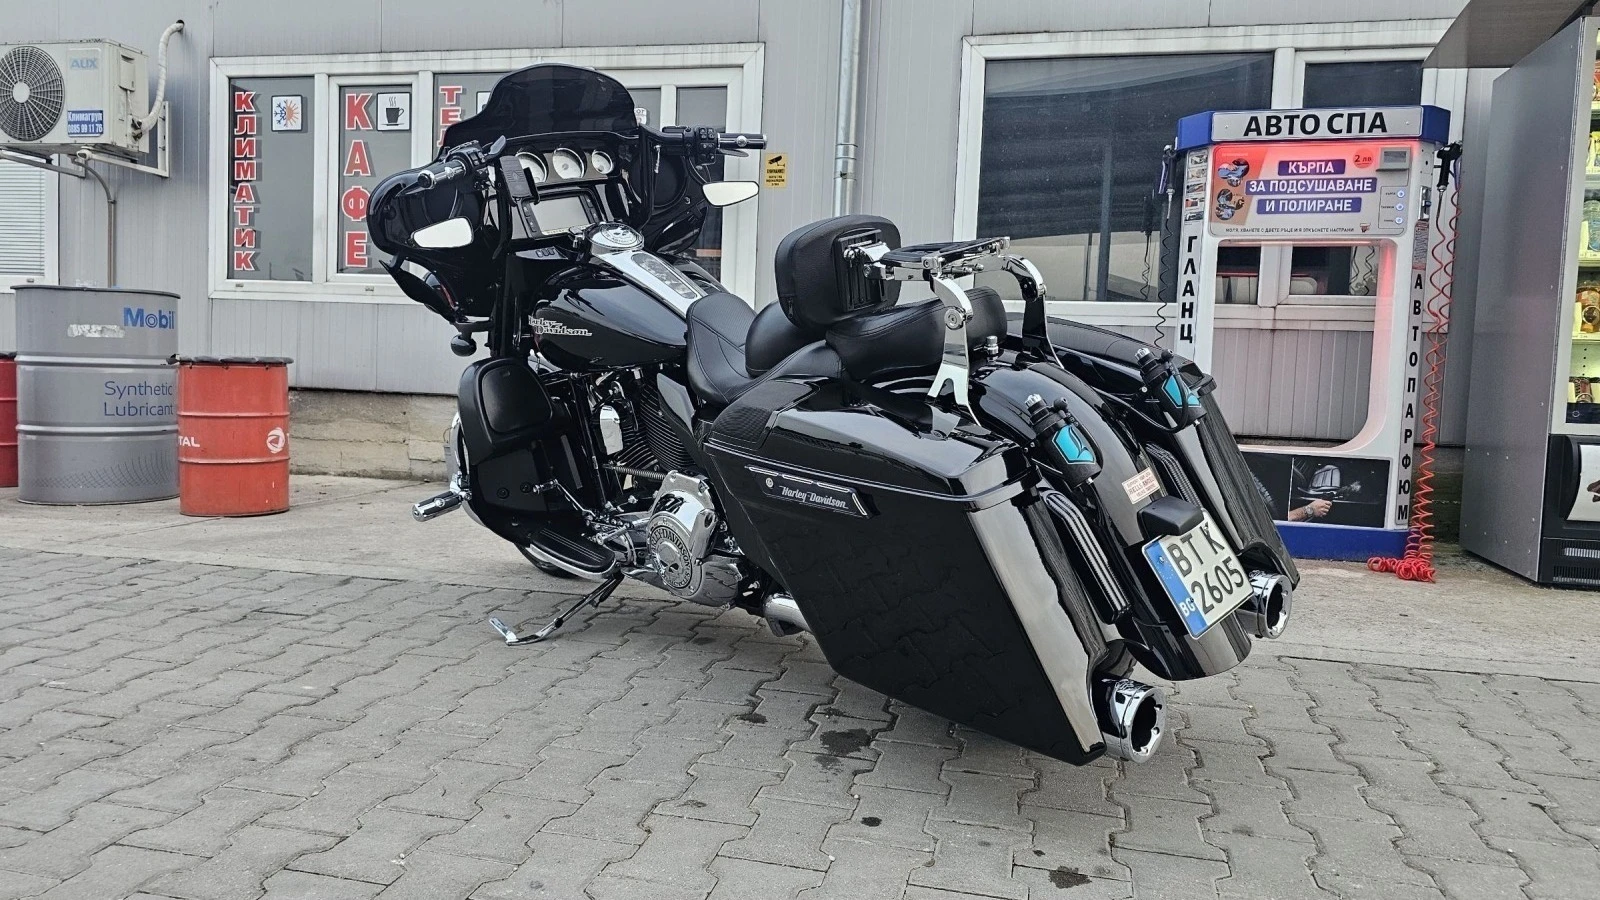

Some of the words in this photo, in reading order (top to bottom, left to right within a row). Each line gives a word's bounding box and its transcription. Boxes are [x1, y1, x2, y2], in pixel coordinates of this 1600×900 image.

[70, 59, 97, 69] AUX
[68, 112, 103, 122] Климагруп
[1243, 113, 1320, 137] АВТО
[1327, 112, 1388, 134] СПА
[68, 124, 80, 133] 0885
[81, 124, 88, 133] 99
[89, 124, 95, 133] 11
[1288, 161, 1334, 174] КЪРПА
[1355, 154, 1361, 162] 2
[234, 91, 256, 271] КЛИМАТИК
[341, 93, 373, 268] КАФЕ
[1249, 180, 1267, 192] ЗА
[1269, 179, 1373, 193] ПОДСУШАВАНЕ
[1265, 200, 1276, 212] И
[1279, 199, 1352, 212] ПОЛИРАНЕ
[1180, 236, 1198, 343] ГЛАНЦ
[124, 307, 174, 329] Mobil
[104, 380, 173, 400] Synthetic
[1398, 273, 1422, 521] АВТОПАРФЮМ
[104, 401, 173, 417] Lubricant
[1166, 533, 1204, 577] BT
[1199, 522, 1225, 555] K
[1190, 556, 1244, 615] 2605
[1179, 598, 1196, 617] BG
